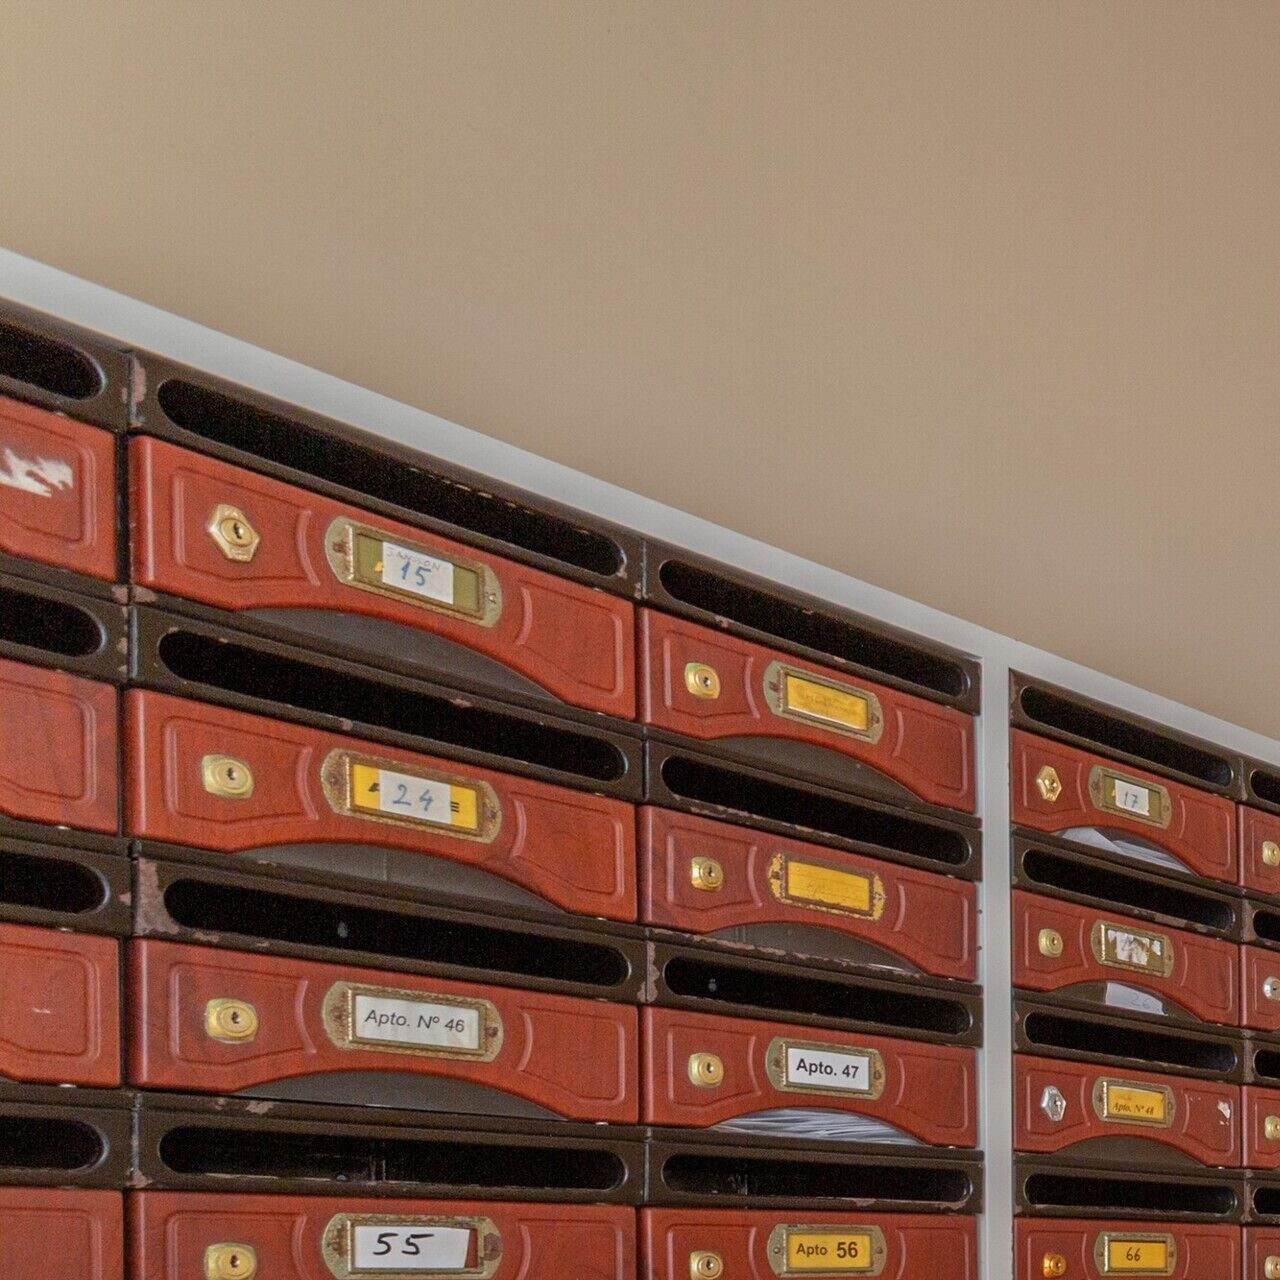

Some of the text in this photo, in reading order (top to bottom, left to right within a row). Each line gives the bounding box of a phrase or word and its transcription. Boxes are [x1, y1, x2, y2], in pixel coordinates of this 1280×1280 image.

[400, 560, 432, 587] 15
[393, 783, 434, 812] 24
[1124, 791, 1139, 809] 17
[365, 1009, 411, 1027] Apto.
[445, 1018, 465, 1033] 46
[796, 1058, 859, 1079] Apto. 47
[372, 1232, 435, 1256] 55
[796, 1241, 859, 1259] Apto 56
[1126, 1246, 1141, 1262] 66
